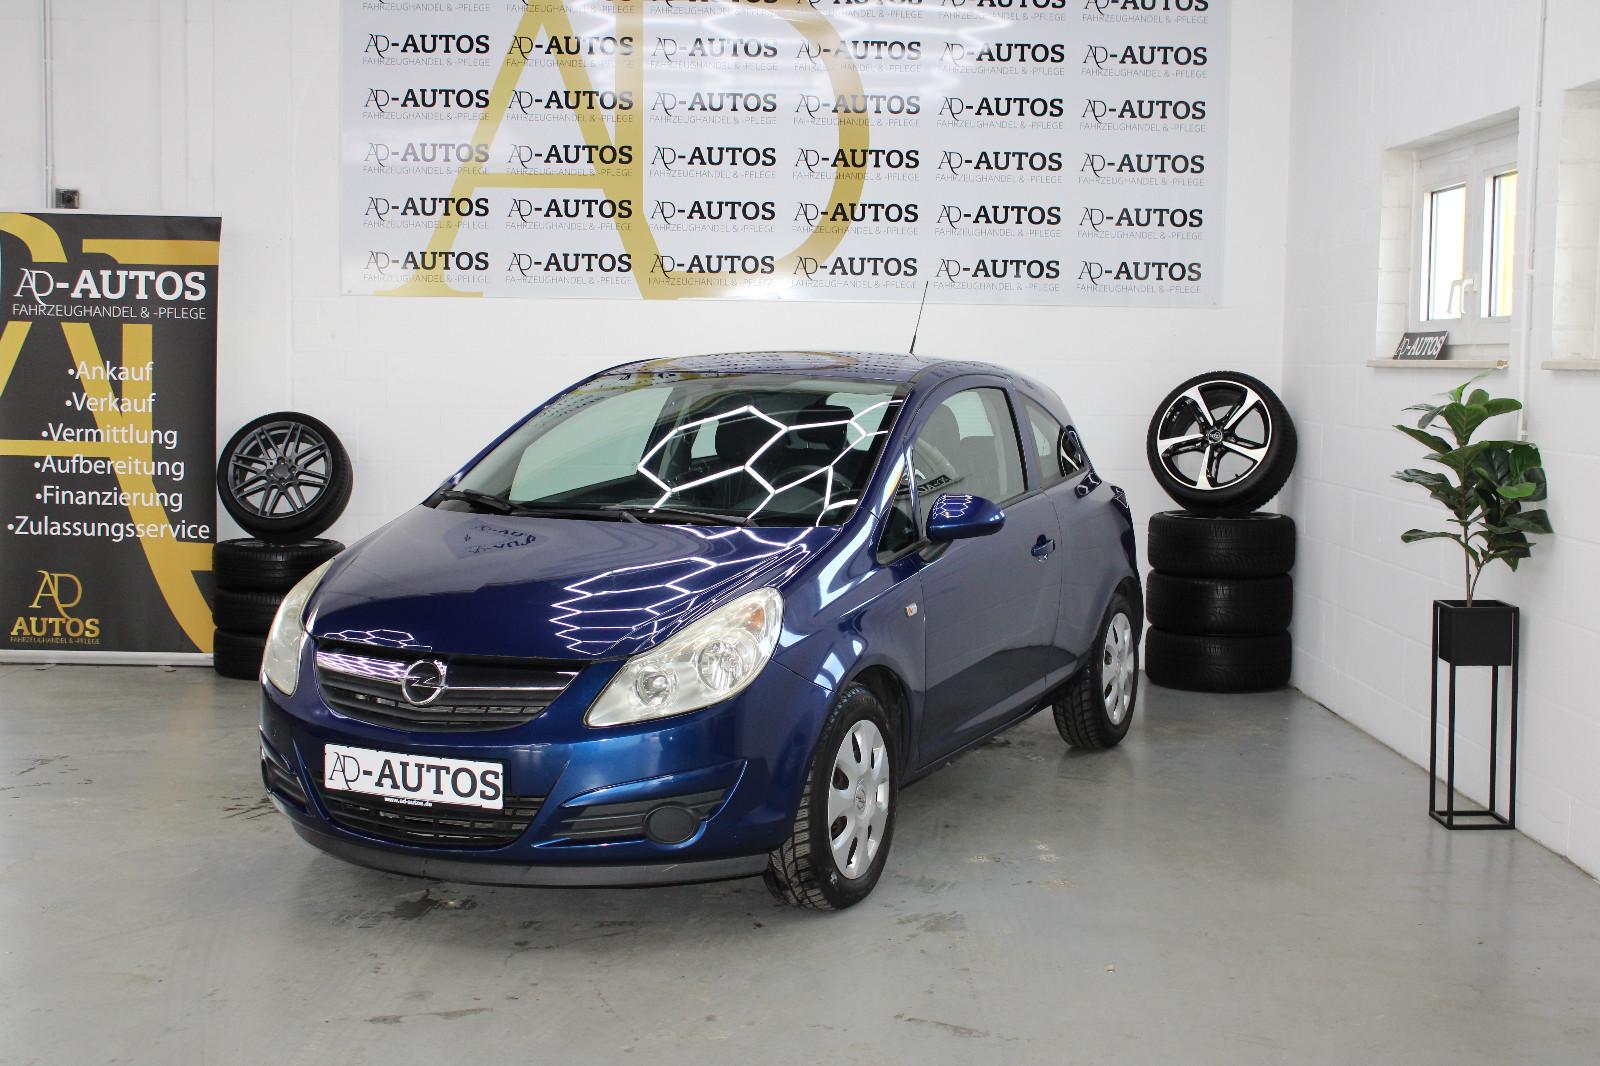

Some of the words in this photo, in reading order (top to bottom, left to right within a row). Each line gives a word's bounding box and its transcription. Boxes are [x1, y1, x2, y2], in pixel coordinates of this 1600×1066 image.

[365, 34, 489, 58] AD-AUTOS
[1083, 45, 1207, 69] AD-AUTOS
[365, 88, 489, 112] AD-AUTOS
[508, 90, 633, 114] AD-AUTOS
[652, 93, 776, 117] AD-AUTOS
[795, 95, 920, 119] AD-AUTOS
[939, 97, 1063, 121] AD-AUTOS
[1082, 99, 1205, 123] AD-AUTOS
[365, 142, 489, 166] AD-AUTOS
[508, 144, 633, 168] AD-AUTOS
[651, 147, 776, 171] AD-AUTOS
[795, 149, 919, 173] AD-AUTOS
[938, 151, 1062, 175] AD-AUTOS
[1081, 153, 1204, 177] AD-AUTOS
[365, 196, 489, 220] AD-AUTOS
[508, 198, 632, 222] AD-AUTOS
[651, 201, 775, 225] AD-AUTOS
[794, 203, 918, 227] AD-AUTOS
[937, 205, 1060, 229] AD-AUTOS
[1079, 207, 1202, 231] AD-AUTOS
[365, 250, 489, 274] AD-AUTOS
[508, 253, 632, 276] AD-AUTOS
[650, 255, 774, 278] AD-AUTOS
[793, 257, 917, 281] AD-AUTOS
[936, 259, 1059, 283] AD-AUTOS
[1078, 261, 1201, 285] AD-AUTOS
[13, 268, 206, 306] AD-AUTOS
[12, 304, 137, 318] FAHRZEUGHANDEL
[140, 307, 150, 318] &
[153, 307, 206, 319] -PFLEGE
[11, 617, 100, 638] AUTOS
[329, 752, 501, 800] AD-AUTOS
